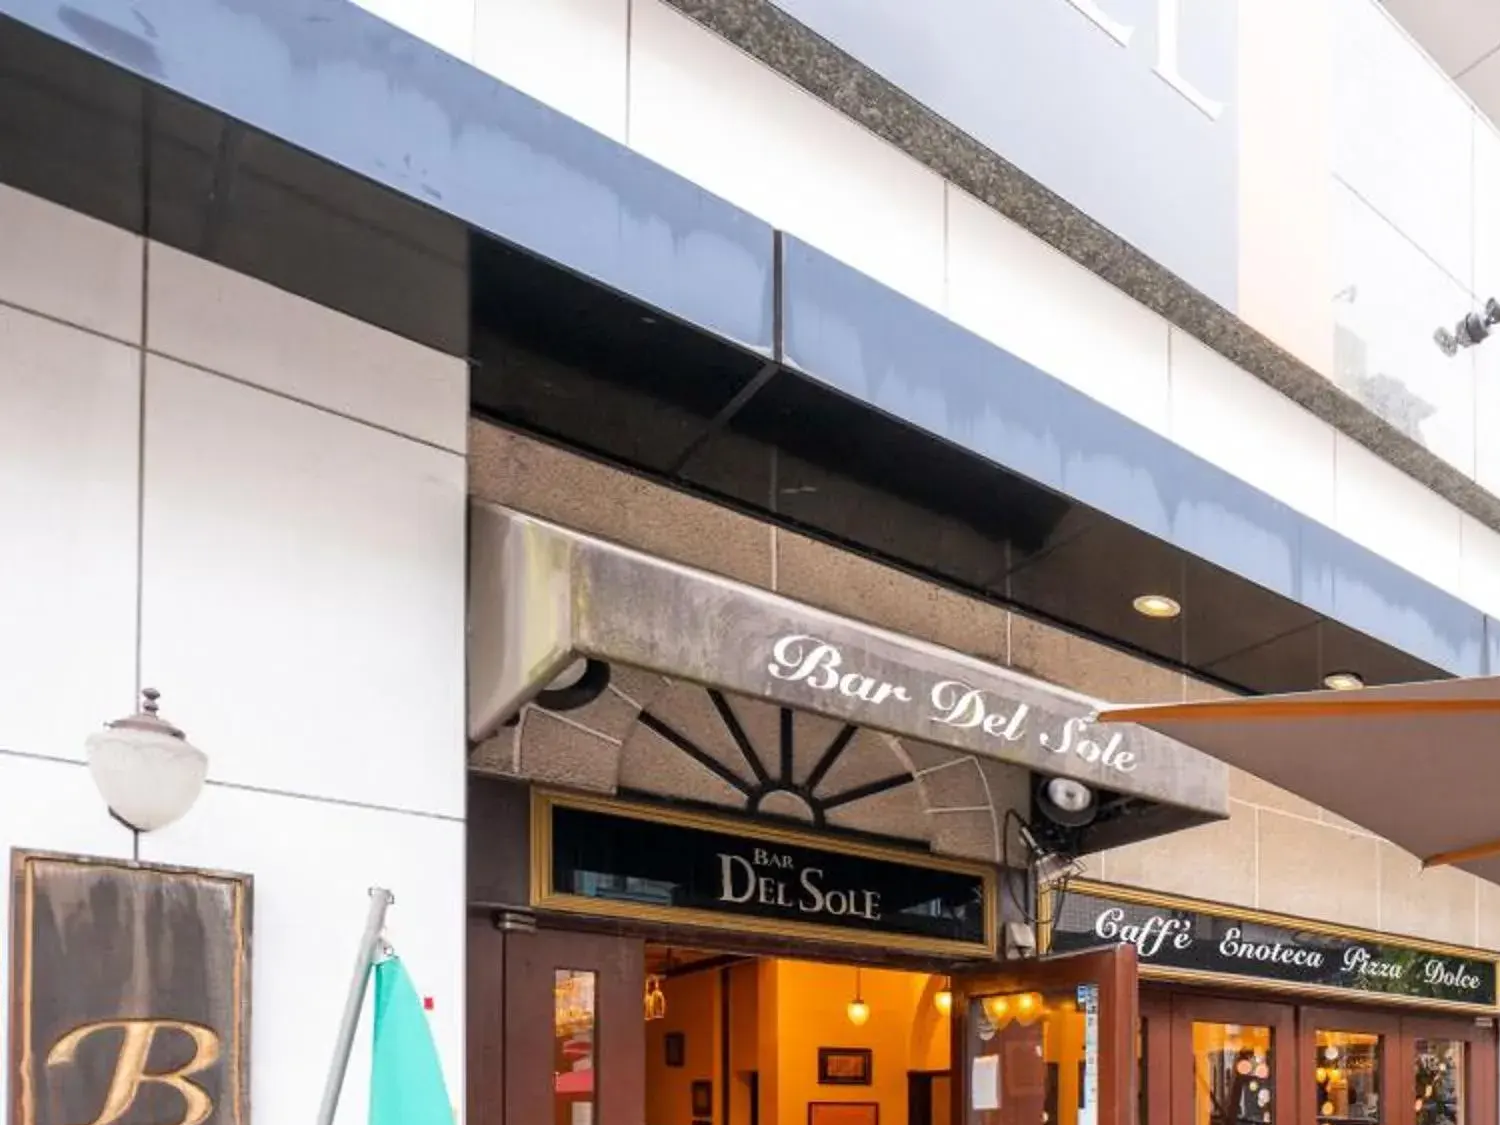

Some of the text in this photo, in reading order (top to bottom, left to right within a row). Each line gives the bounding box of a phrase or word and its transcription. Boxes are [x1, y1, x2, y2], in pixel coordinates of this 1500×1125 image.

[768, 634, 1138, 773] Bar Del Sole
[1219, 927, 1326, 969] Enoteca
[1340, 946, 1403, 980] Pizza
[1424, 960, 1481, 991] Dolce
